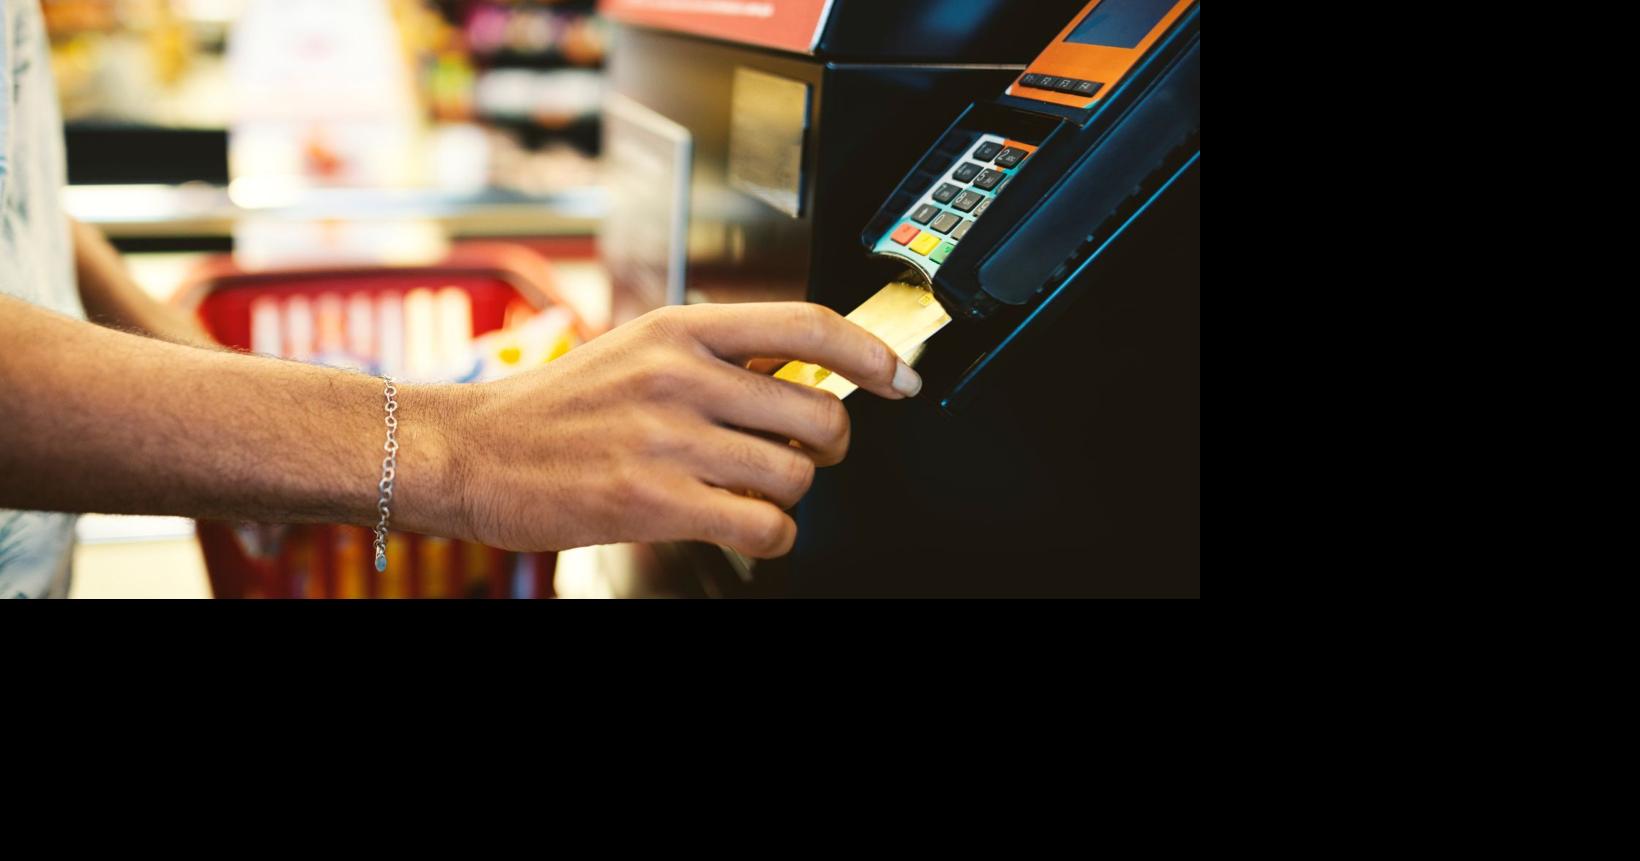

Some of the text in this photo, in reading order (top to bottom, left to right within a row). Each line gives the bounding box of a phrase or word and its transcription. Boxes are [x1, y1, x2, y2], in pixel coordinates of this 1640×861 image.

[1041, 77, 1052, 85] F2
[1060, 79, 1071, 87] F3
[997, 149, 1010, 161] 2
[976, 170, 989, 182] 5
[955, 192, 967, 203] 8
[934, 214, 946, 225] 0
